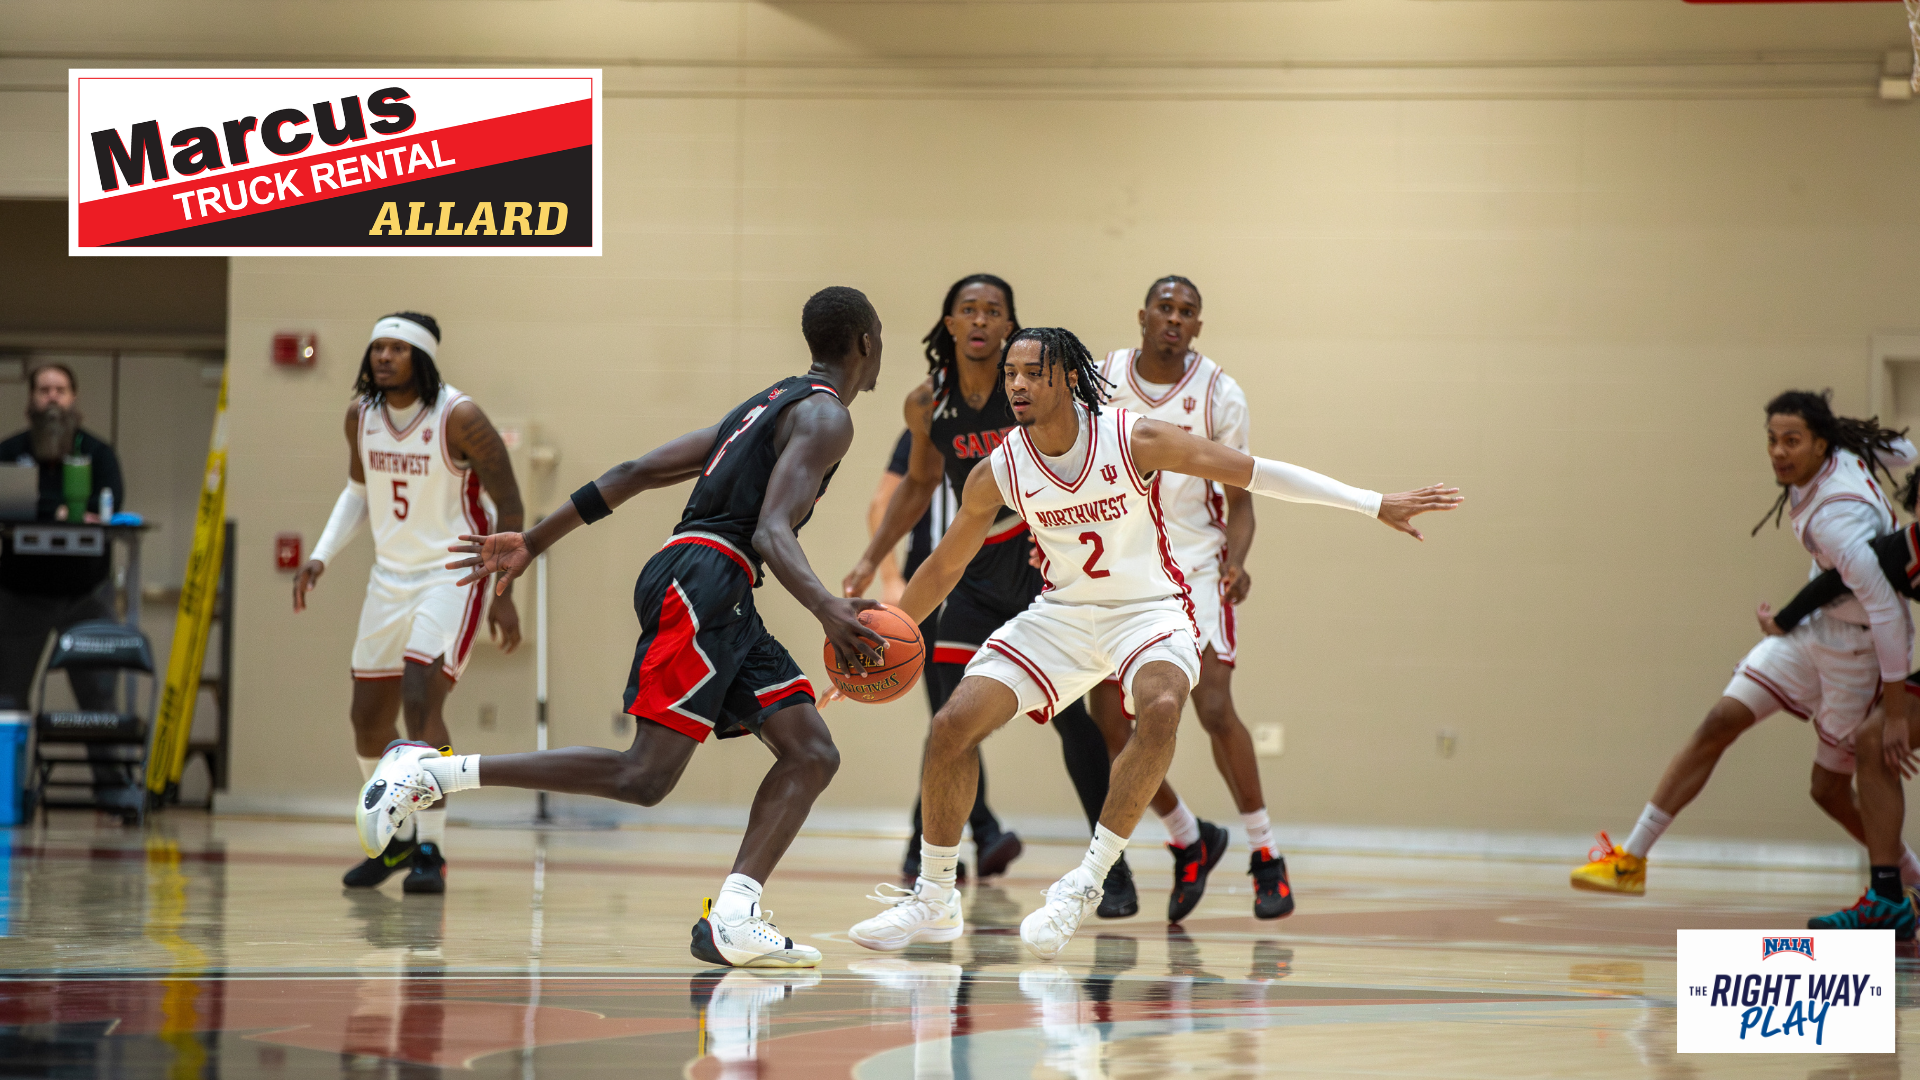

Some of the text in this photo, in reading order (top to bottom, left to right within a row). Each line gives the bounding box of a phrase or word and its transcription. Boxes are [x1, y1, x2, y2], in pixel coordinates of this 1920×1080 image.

[952, 425, 1018, 460] SAIN
[368, 448, 431, 477] NORTHWEST
[391, 479, 410, 521] 5
[1035, 493, 1128, 527] NORTHWEST
[1078, 531, 1111, 579] 2
